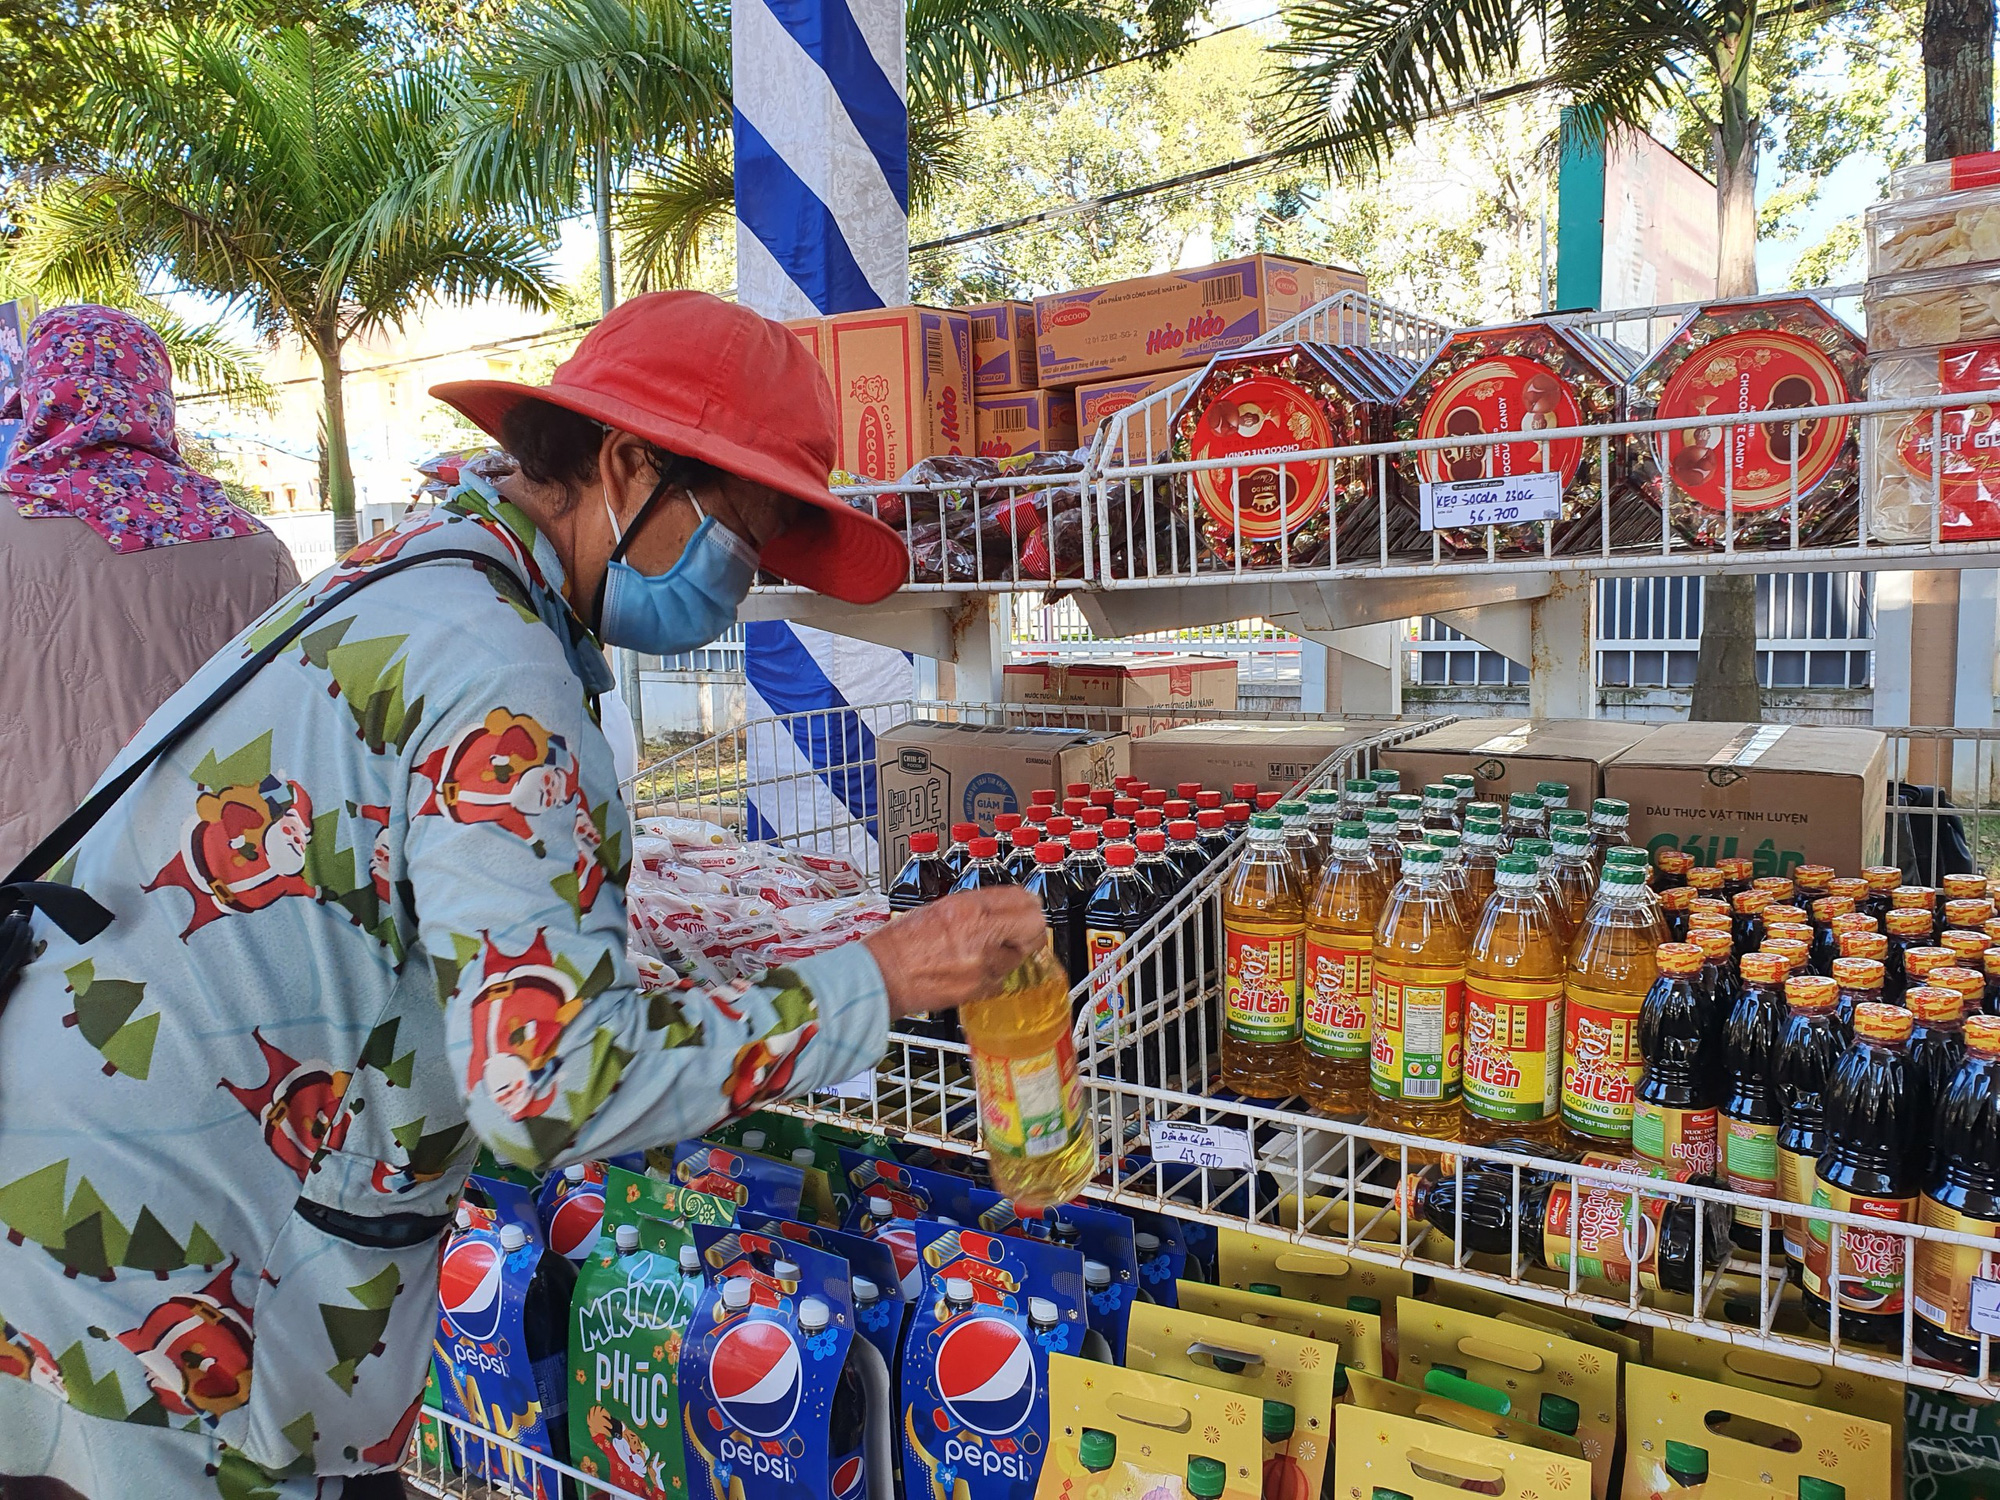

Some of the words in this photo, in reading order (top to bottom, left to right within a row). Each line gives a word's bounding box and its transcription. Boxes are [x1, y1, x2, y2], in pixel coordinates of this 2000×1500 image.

[1146, 322, 1184, 356] Hảo
[1187, 309, 1225, 343] Hảo
[937, 386, 960, 442] Hảo
[1498, 397, 1509, 429] CANDY
[1737, 373, 1750, 433] CHOCOLE
[881, 405, 894, 440] Cook
[864, 413, 878, 476] ACECO
[1735, 435, 1746, 469] CANDY
[903, 754, 927, 764] CHIN-SU
[977, 797, 1000, 810] GIẢM
[978, 811, 997, 824] MẶ
[1674, 807, 1707, 820] THỰC
[1710, 808, 1733, 821] VẬT
[1736, 810, 1764, 822] TINH
[1767, 812, 1809, 825] LUYỆN
[1231, 1010, 1270, 1023] COOKING
[1307, 1022, 1345, 1039] COOKING
[1347, 1032, 1362, 1040] OIL
[1498, 1091, 1516, 1100] OIL
[1565, 1093, 1609, 1114] COOKING
[1612, 1107, 1631, 1116] OIL
[454, 1343, 507, 1377] pepsi
[720, 1439, 791, 1482] pepsi
[945, 1439, 1025, 1481] pepsi
